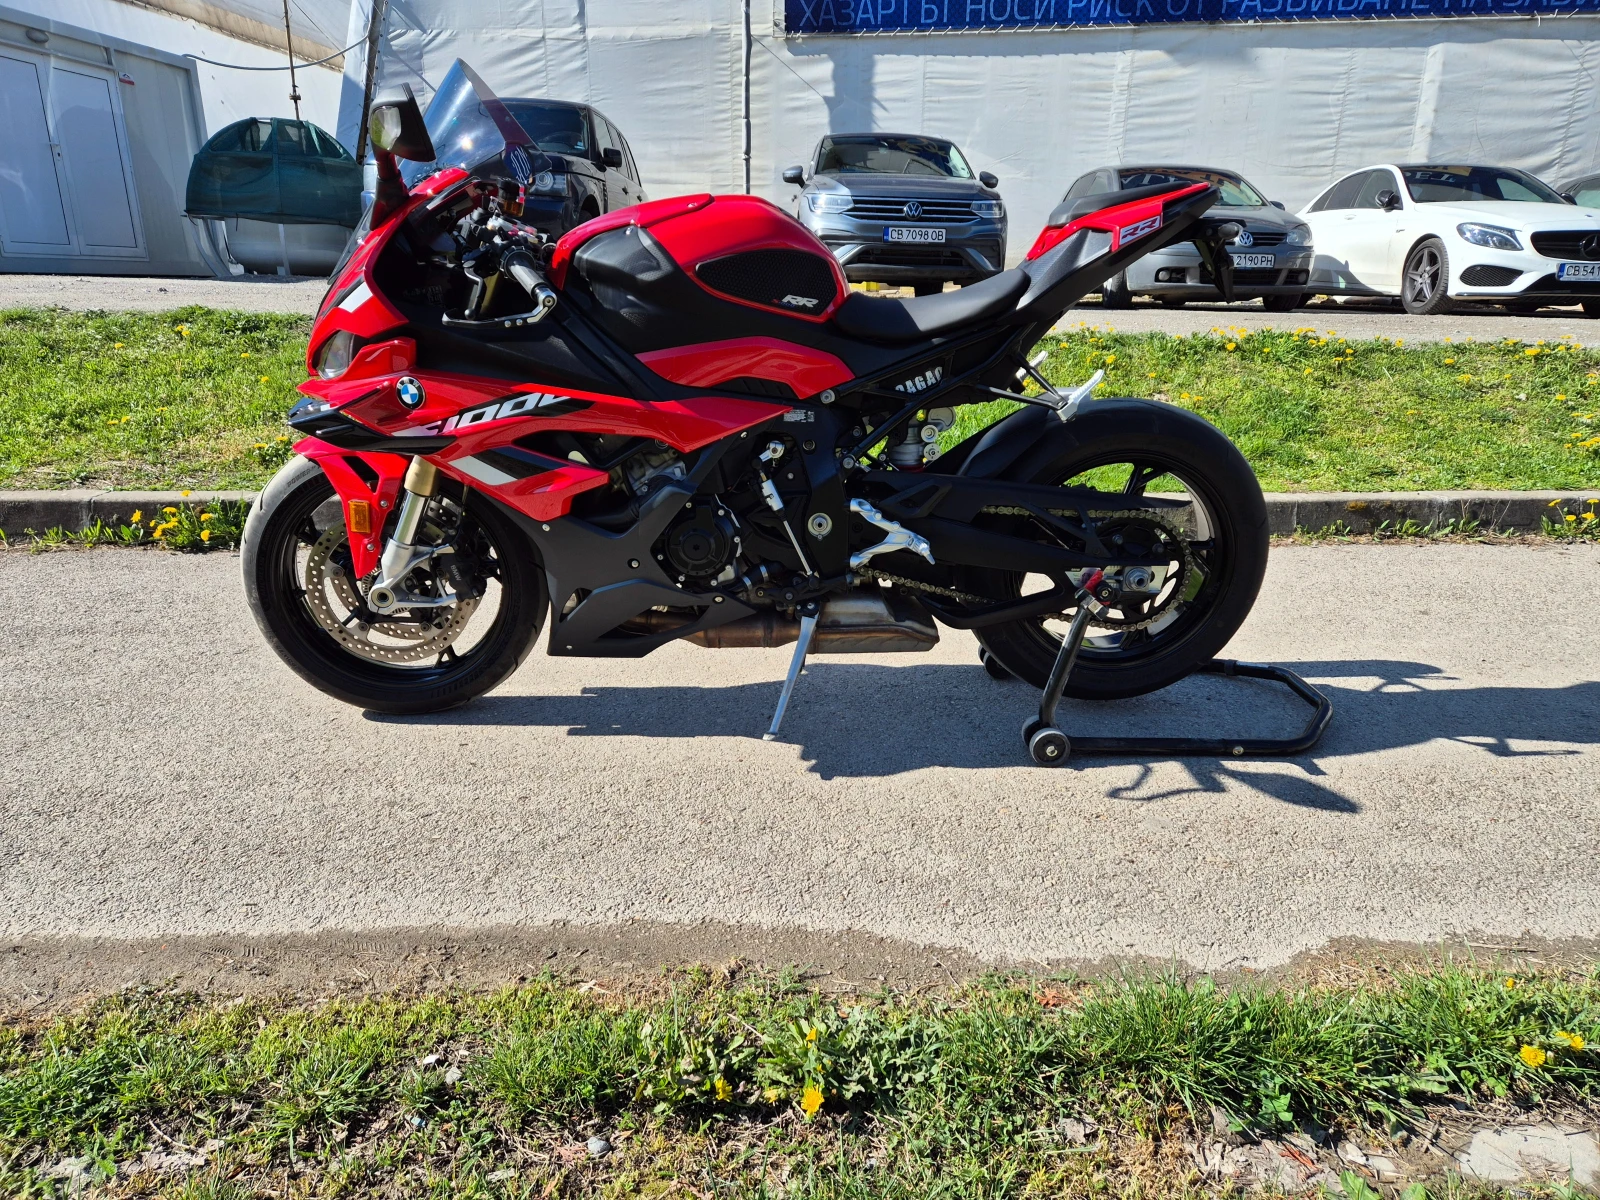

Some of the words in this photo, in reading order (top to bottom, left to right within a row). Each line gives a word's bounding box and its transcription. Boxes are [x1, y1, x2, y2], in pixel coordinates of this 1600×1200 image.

[890, 229, 904, 240] CB
[905, 229, 929, 240] 7098
[931, 230, 944, 241] OB
[1235, 255, 1259, 266] 2190
[1260, 255, 1273, 266] PH
[1566, 265, 1580, 276] CB
[781, 294, 819, 308] RR
[450, 564, 462, 581] BMW
